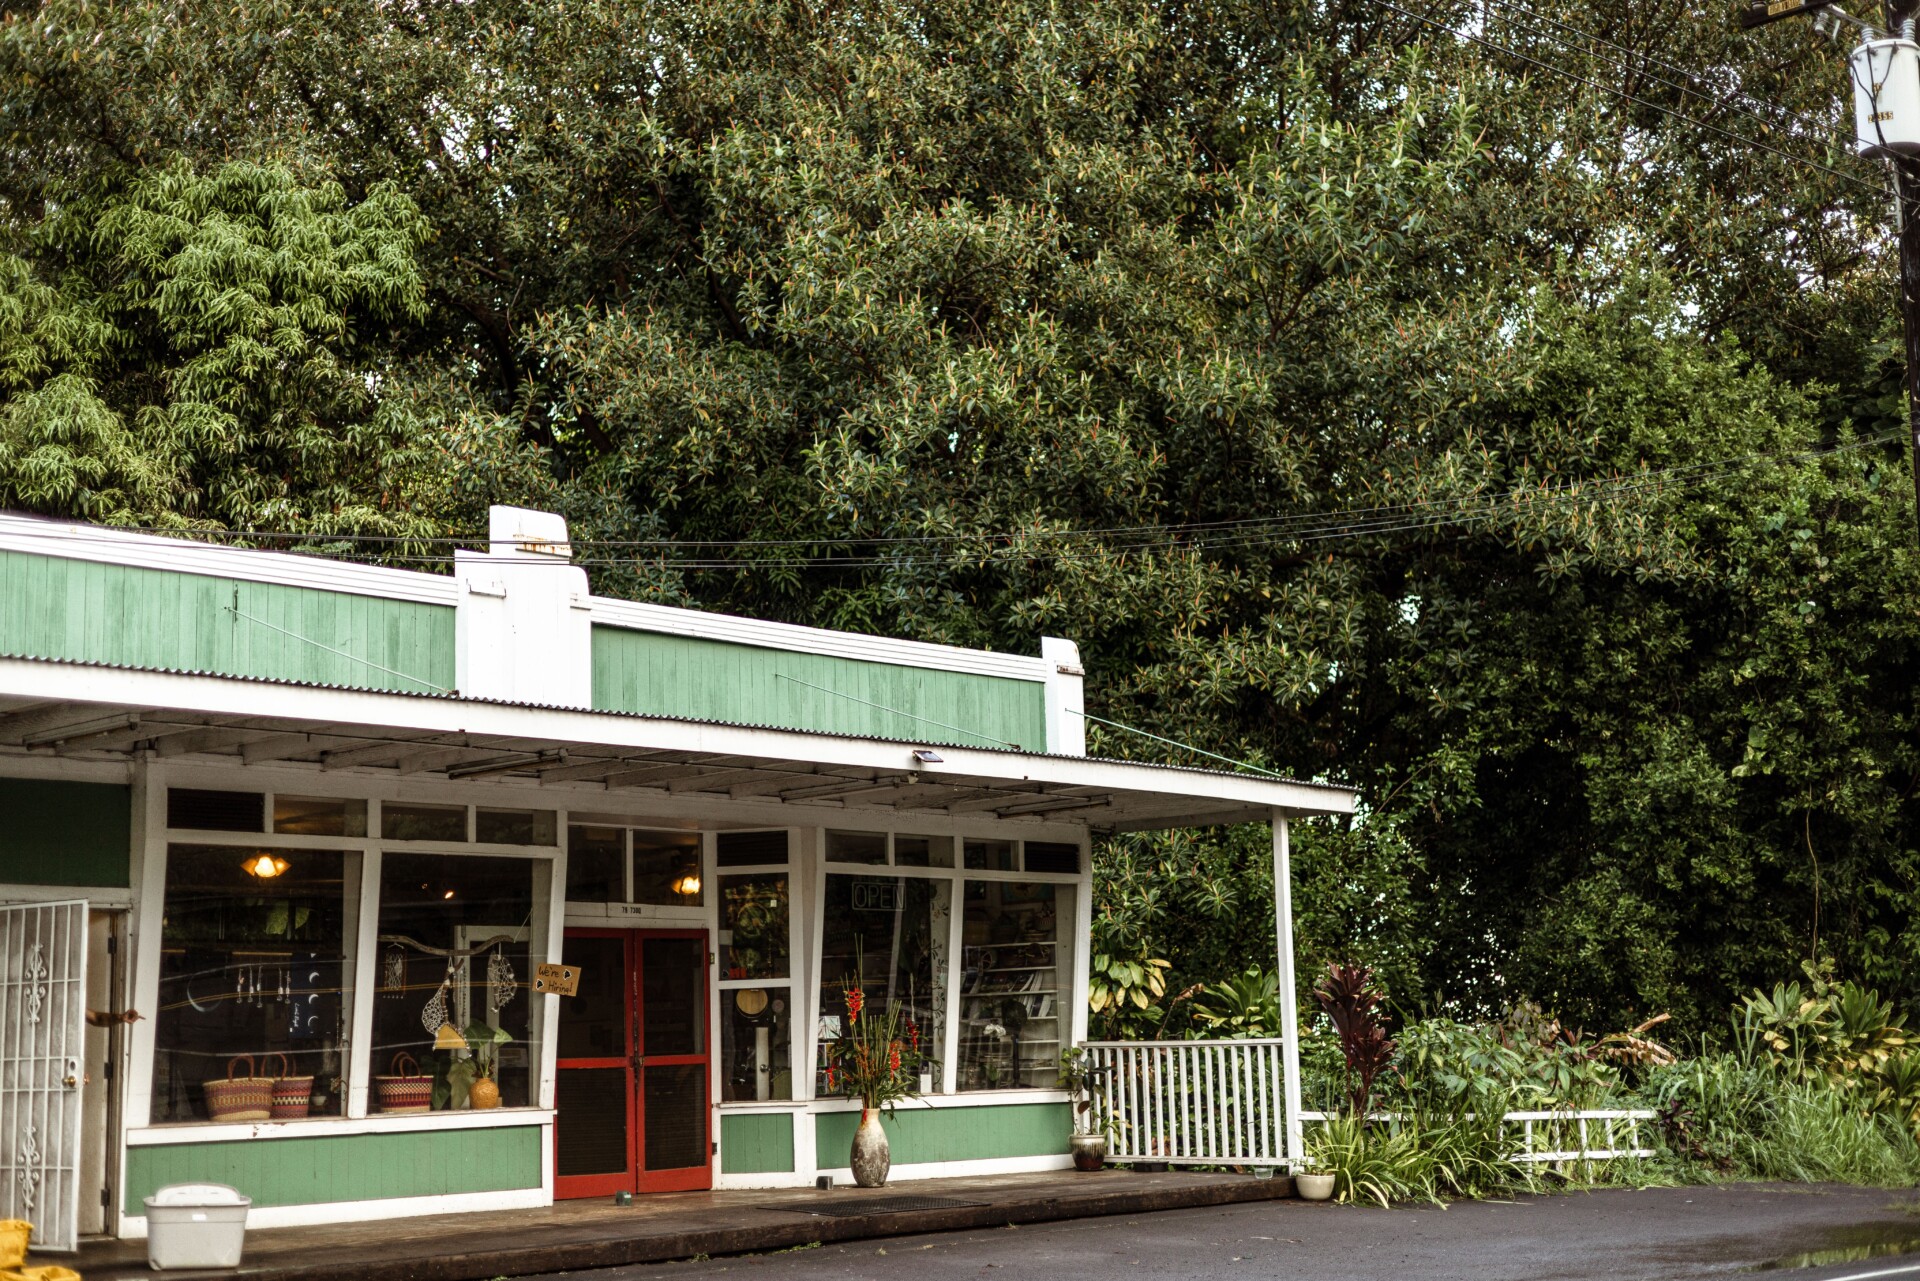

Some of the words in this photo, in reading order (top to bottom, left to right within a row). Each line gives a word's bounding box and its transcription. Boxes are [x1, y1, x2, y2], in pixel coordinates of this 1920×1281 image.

[1868, 111, 1893, 123] 2355
[855, 885, 904, 909] OPEN
[538, 966, 559, 977] We're
[548, 981, 573, 994] Hiring!
